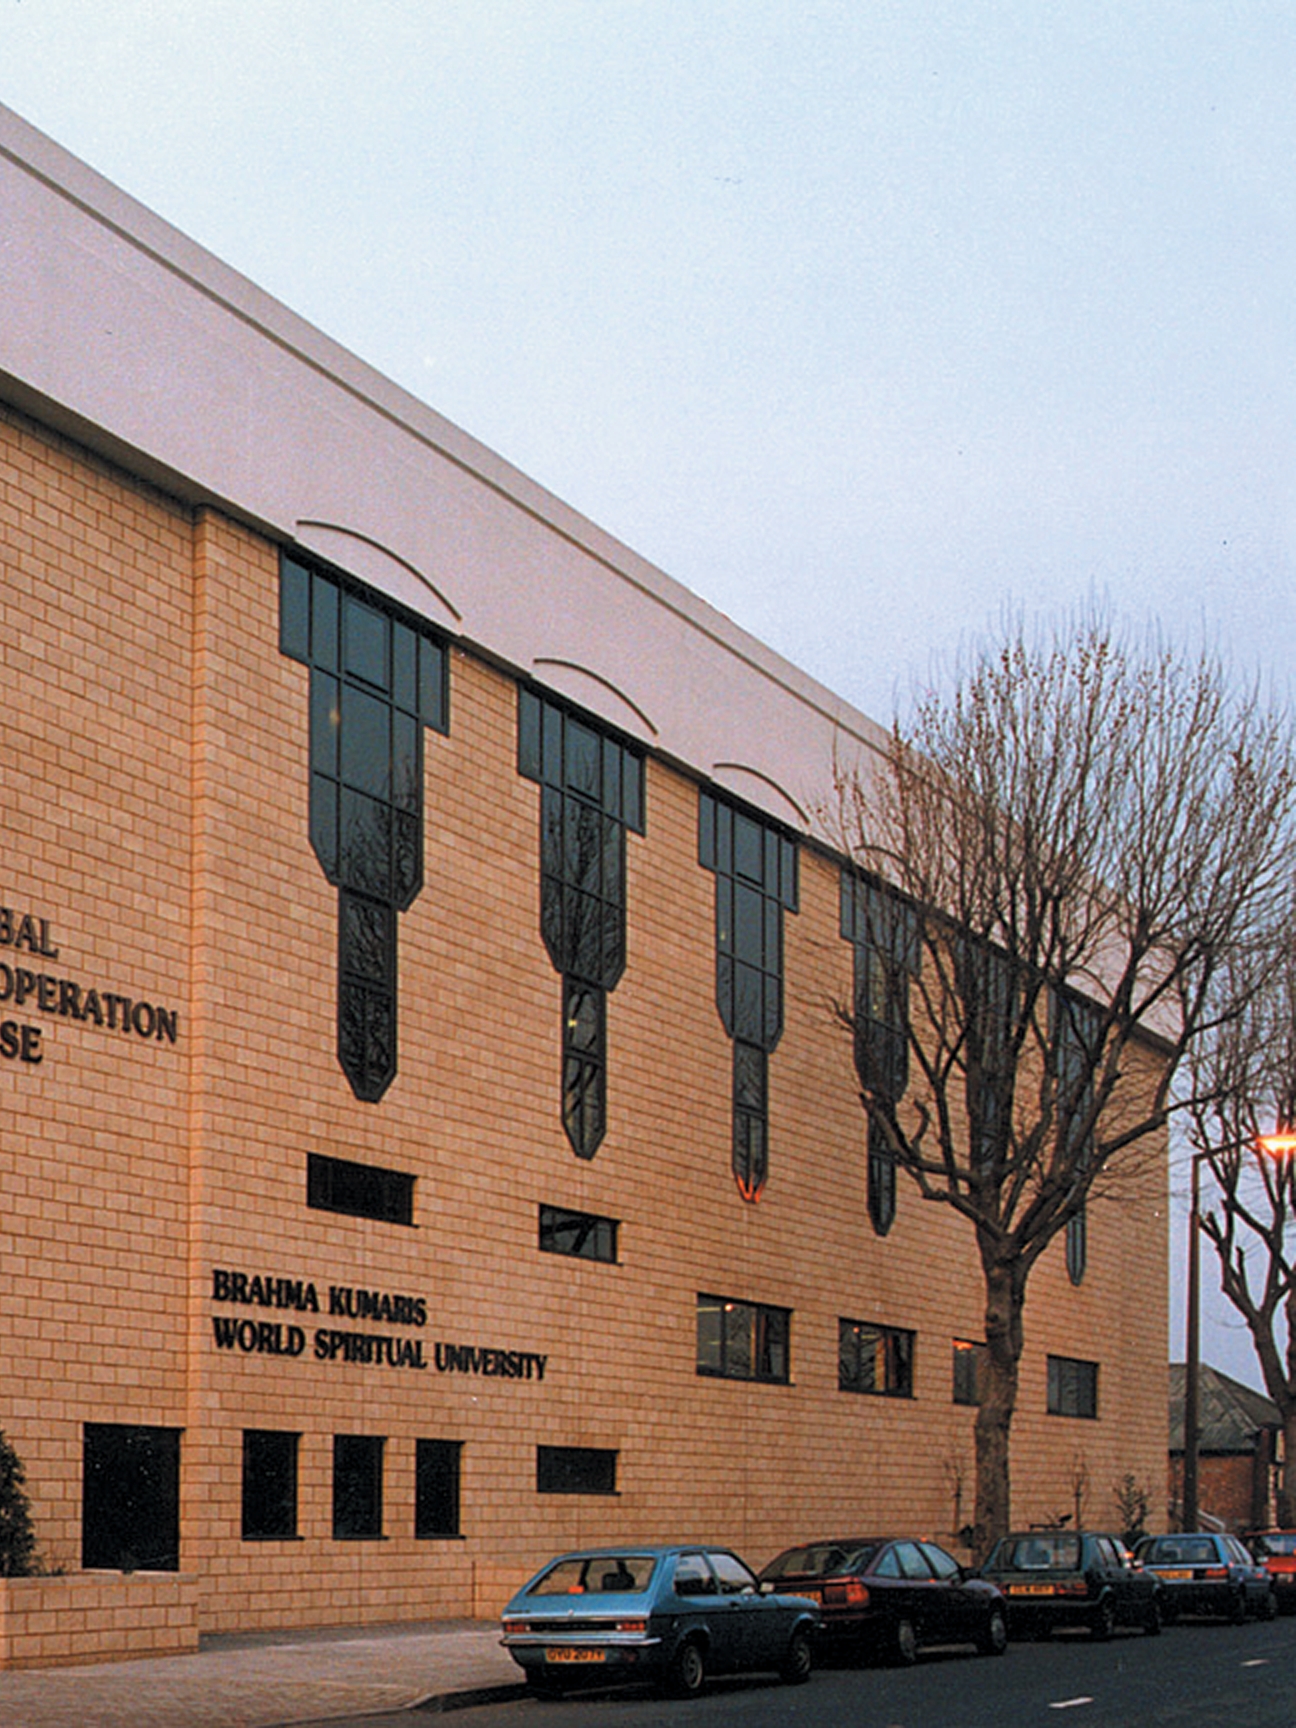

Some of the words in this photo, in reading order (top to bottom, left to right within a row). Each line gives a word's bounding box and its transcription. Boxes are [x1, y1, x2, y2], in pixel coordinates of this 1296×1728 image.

[212, 1269, 320, 1314] BRAHMA
[329, 1285, 427, 1327] KUMARIS
[212, 1317, 305, 1357] WORLD
[314, 1329, 428, 1369] SPIRITUAL
[435, 1342, 548, 1381] UNIVERSITY
